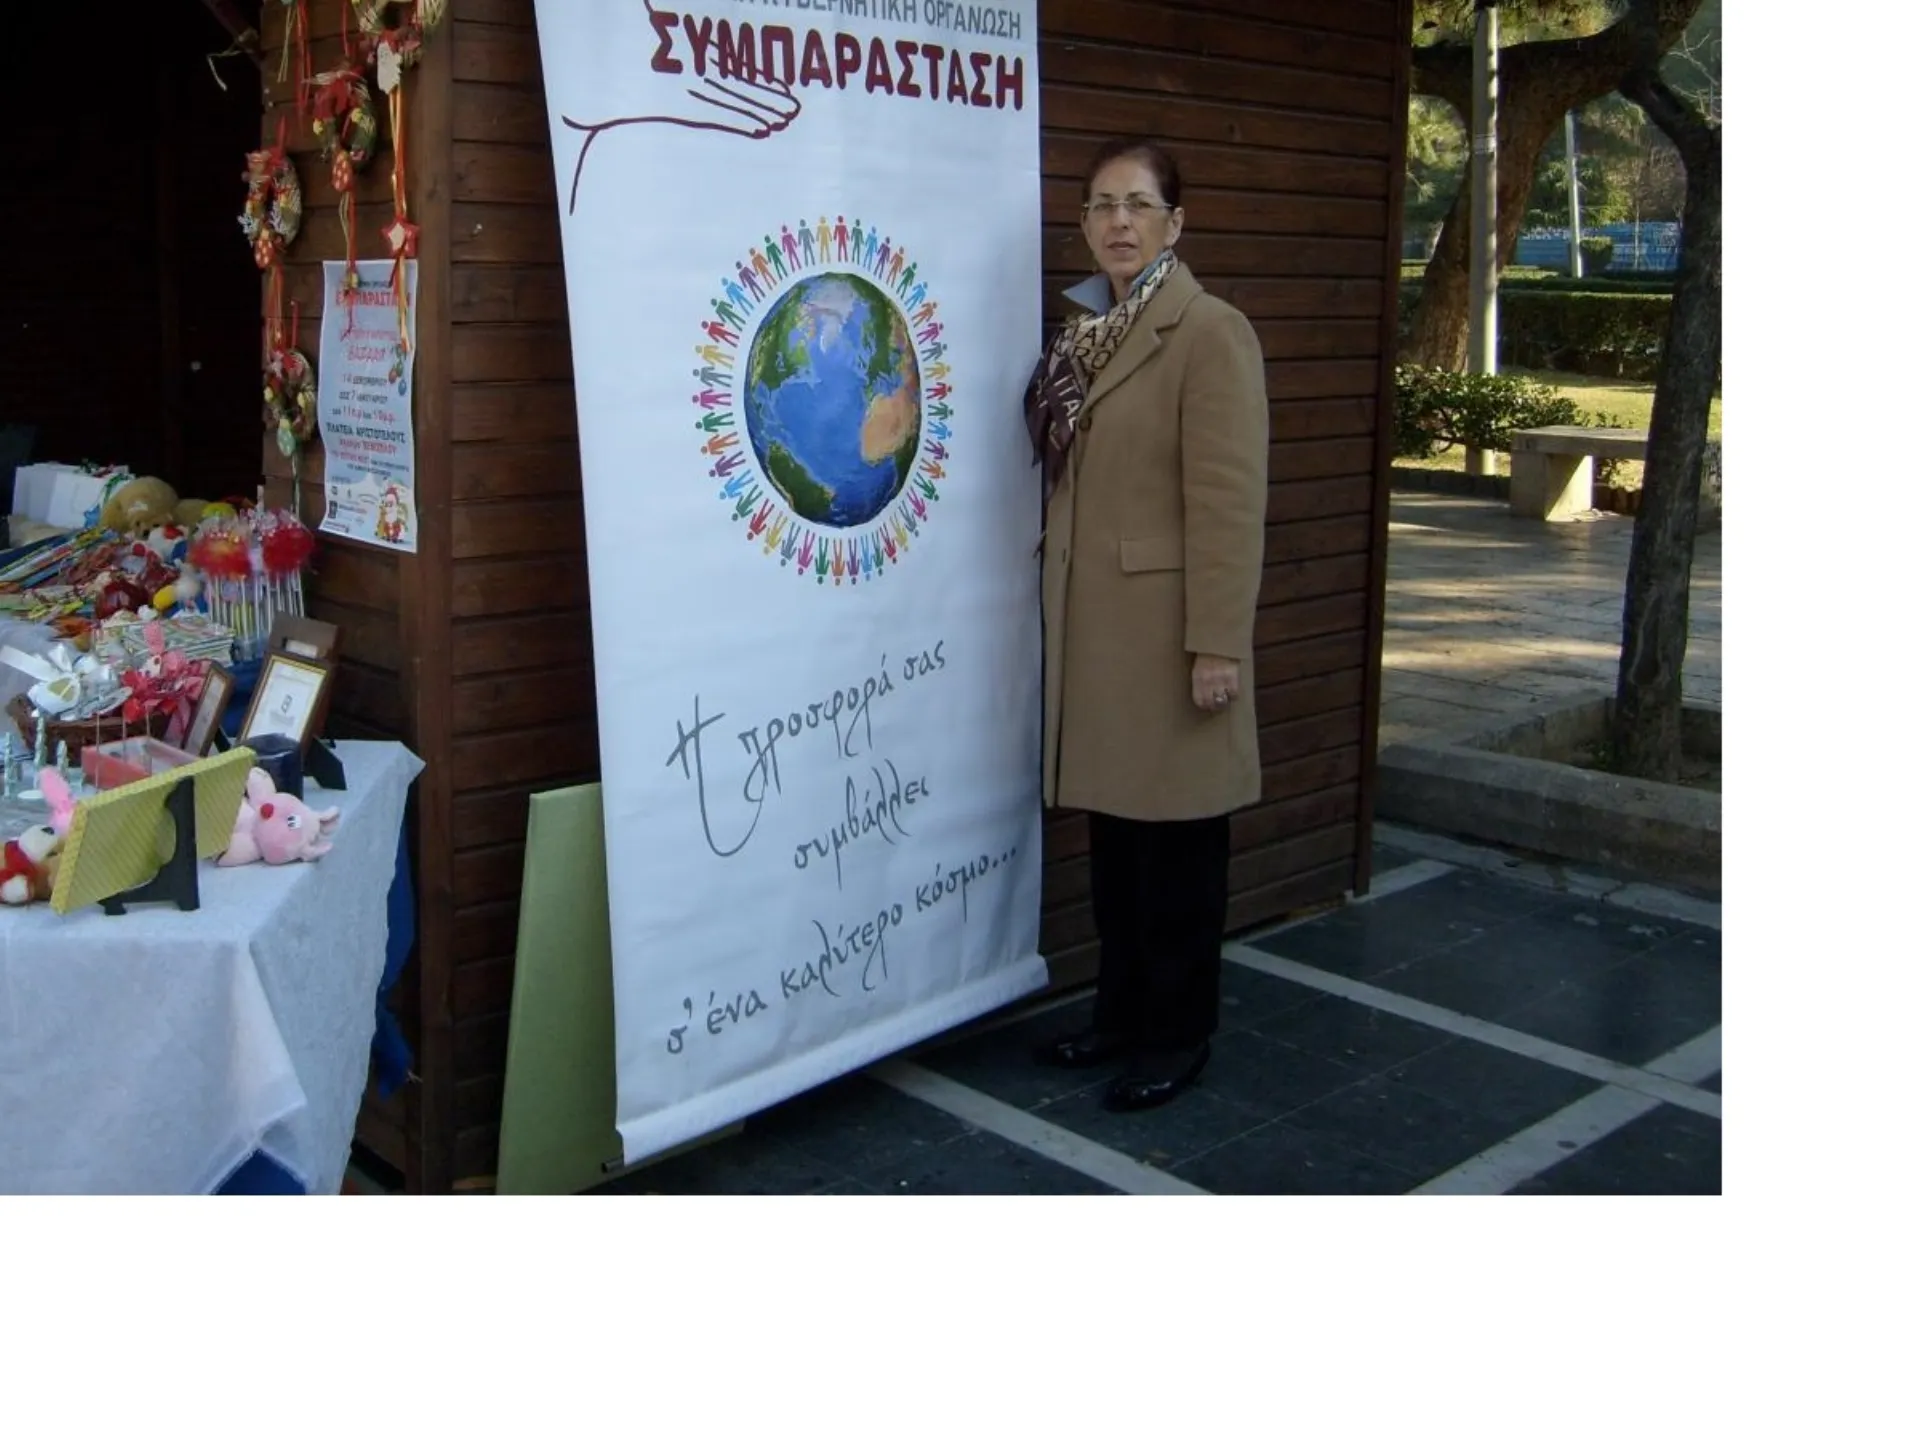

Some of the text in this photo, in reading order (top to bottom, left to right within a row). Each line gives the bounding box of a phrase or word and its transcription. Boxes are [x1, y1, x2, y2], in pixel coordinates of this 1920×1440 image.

[650, 11, 1024, 111] ΣΥΜΠΑΡΑΣΤΑΣΗ
[763, 0, 1022, 40] ΝΗΤΙΚΗ ΟΡΓΑΝΩΣΗ
[738, 653, 894, 802] προσφορά
[903, 640, 945, 681] σας
[794, 758, 930, 891] συμβάλλει
[706, 991, 768, 1036] ένα
[780, 920, 903, 997] καλύτερο
